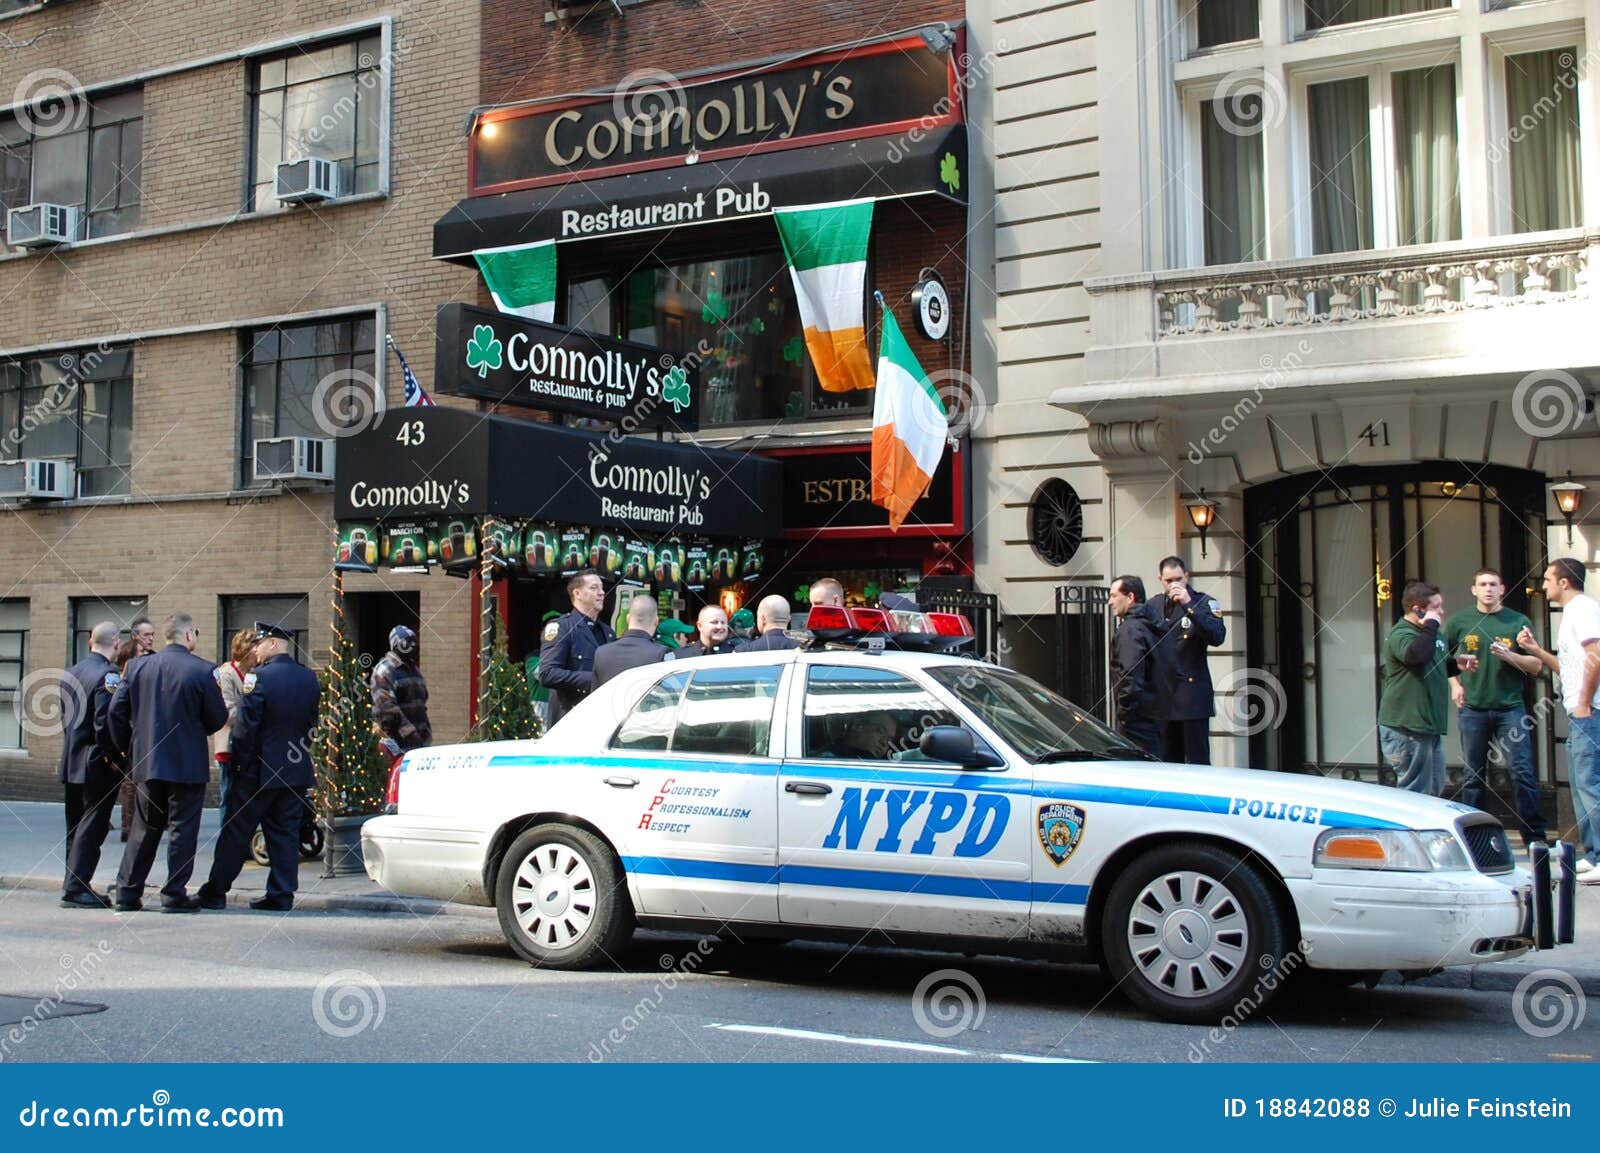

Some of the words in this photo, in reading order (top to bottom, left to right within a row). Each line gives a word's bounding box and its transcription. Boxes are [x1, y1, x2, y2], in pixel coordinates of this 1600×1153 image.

[544, 69, 855, 167] Connolly's
[561, 192, 706, 236] Restaurant
[716, 182, 770, 215] Pub
[507, 332, 660, 401] Connolly's
[593, 389, 604, 404] &
[396, 420, 426, 446] 43
[1358, 422, 1391, 447] 41
[590, 452, 711, 504] Connolly's
[350, 479, 470, 510] Connolly's
[601, 496, 675, 523] Restaurant
[679, 504, 704, 526] Pub
[660, 778, 720, 798] COURTESY
[648, 796, 751, 819] PROFESSIONALISM
[1040, 810, 1083, 825] DEPARTMENT
[1049, 805, 1076, 814] POLICE
[1231, 797, 1318, 825] POLICE
[637, 814, 691, 833] RESPECT
[823, 787, 1010, 858] NYPD
